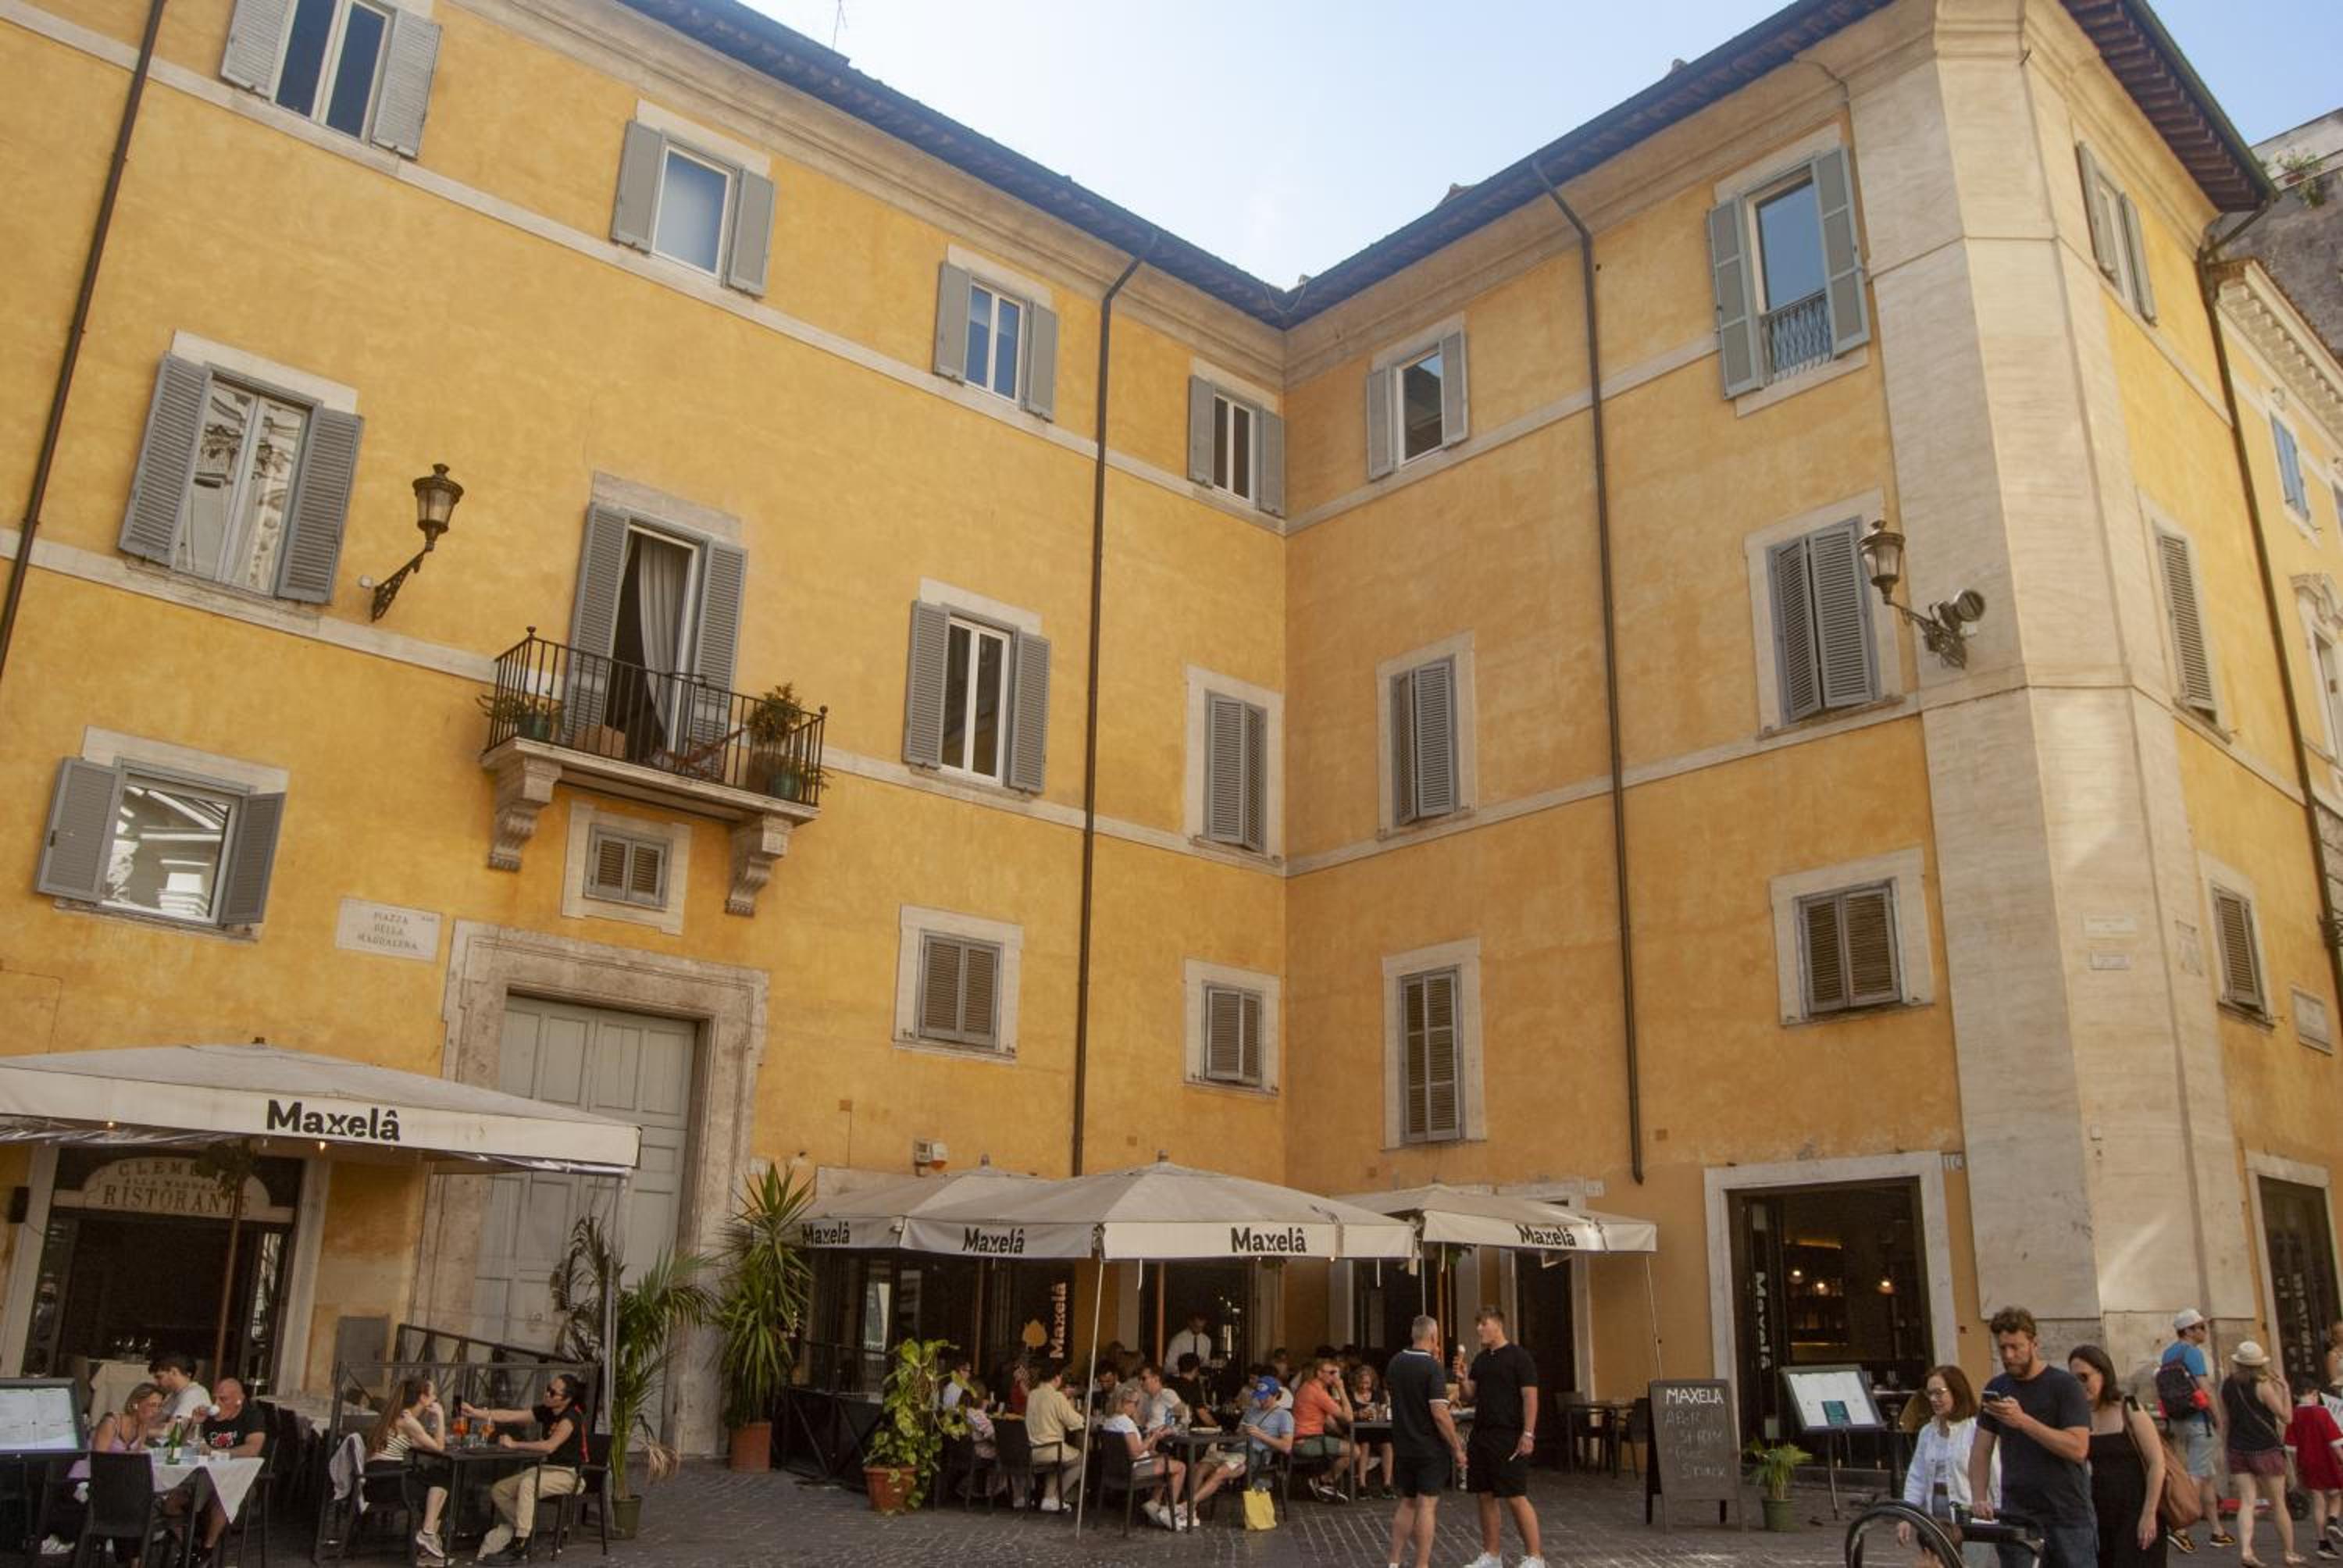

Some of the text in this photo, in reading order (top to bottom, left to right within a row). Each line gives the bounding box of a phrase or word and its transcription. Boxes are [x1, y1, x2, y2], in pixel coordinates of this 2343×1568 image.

[373, 911, 408, 925] PIAZZA
[374, 923, 404, 935] DELLA
[357, 932, 418, 950] MADDALENA
[266, 1099, 400, 1142] Maxelâ
[102, 1184, 251, 1215] RISTORANTE
[801, 1221, 851, 1245] Maxelâ
[961, 1227, 1025, 1255] Maxelâ
[1230, 1226, 1307, 1253] Maxelâ
[1515, 1224, 1577, 1248] Maxelâ
